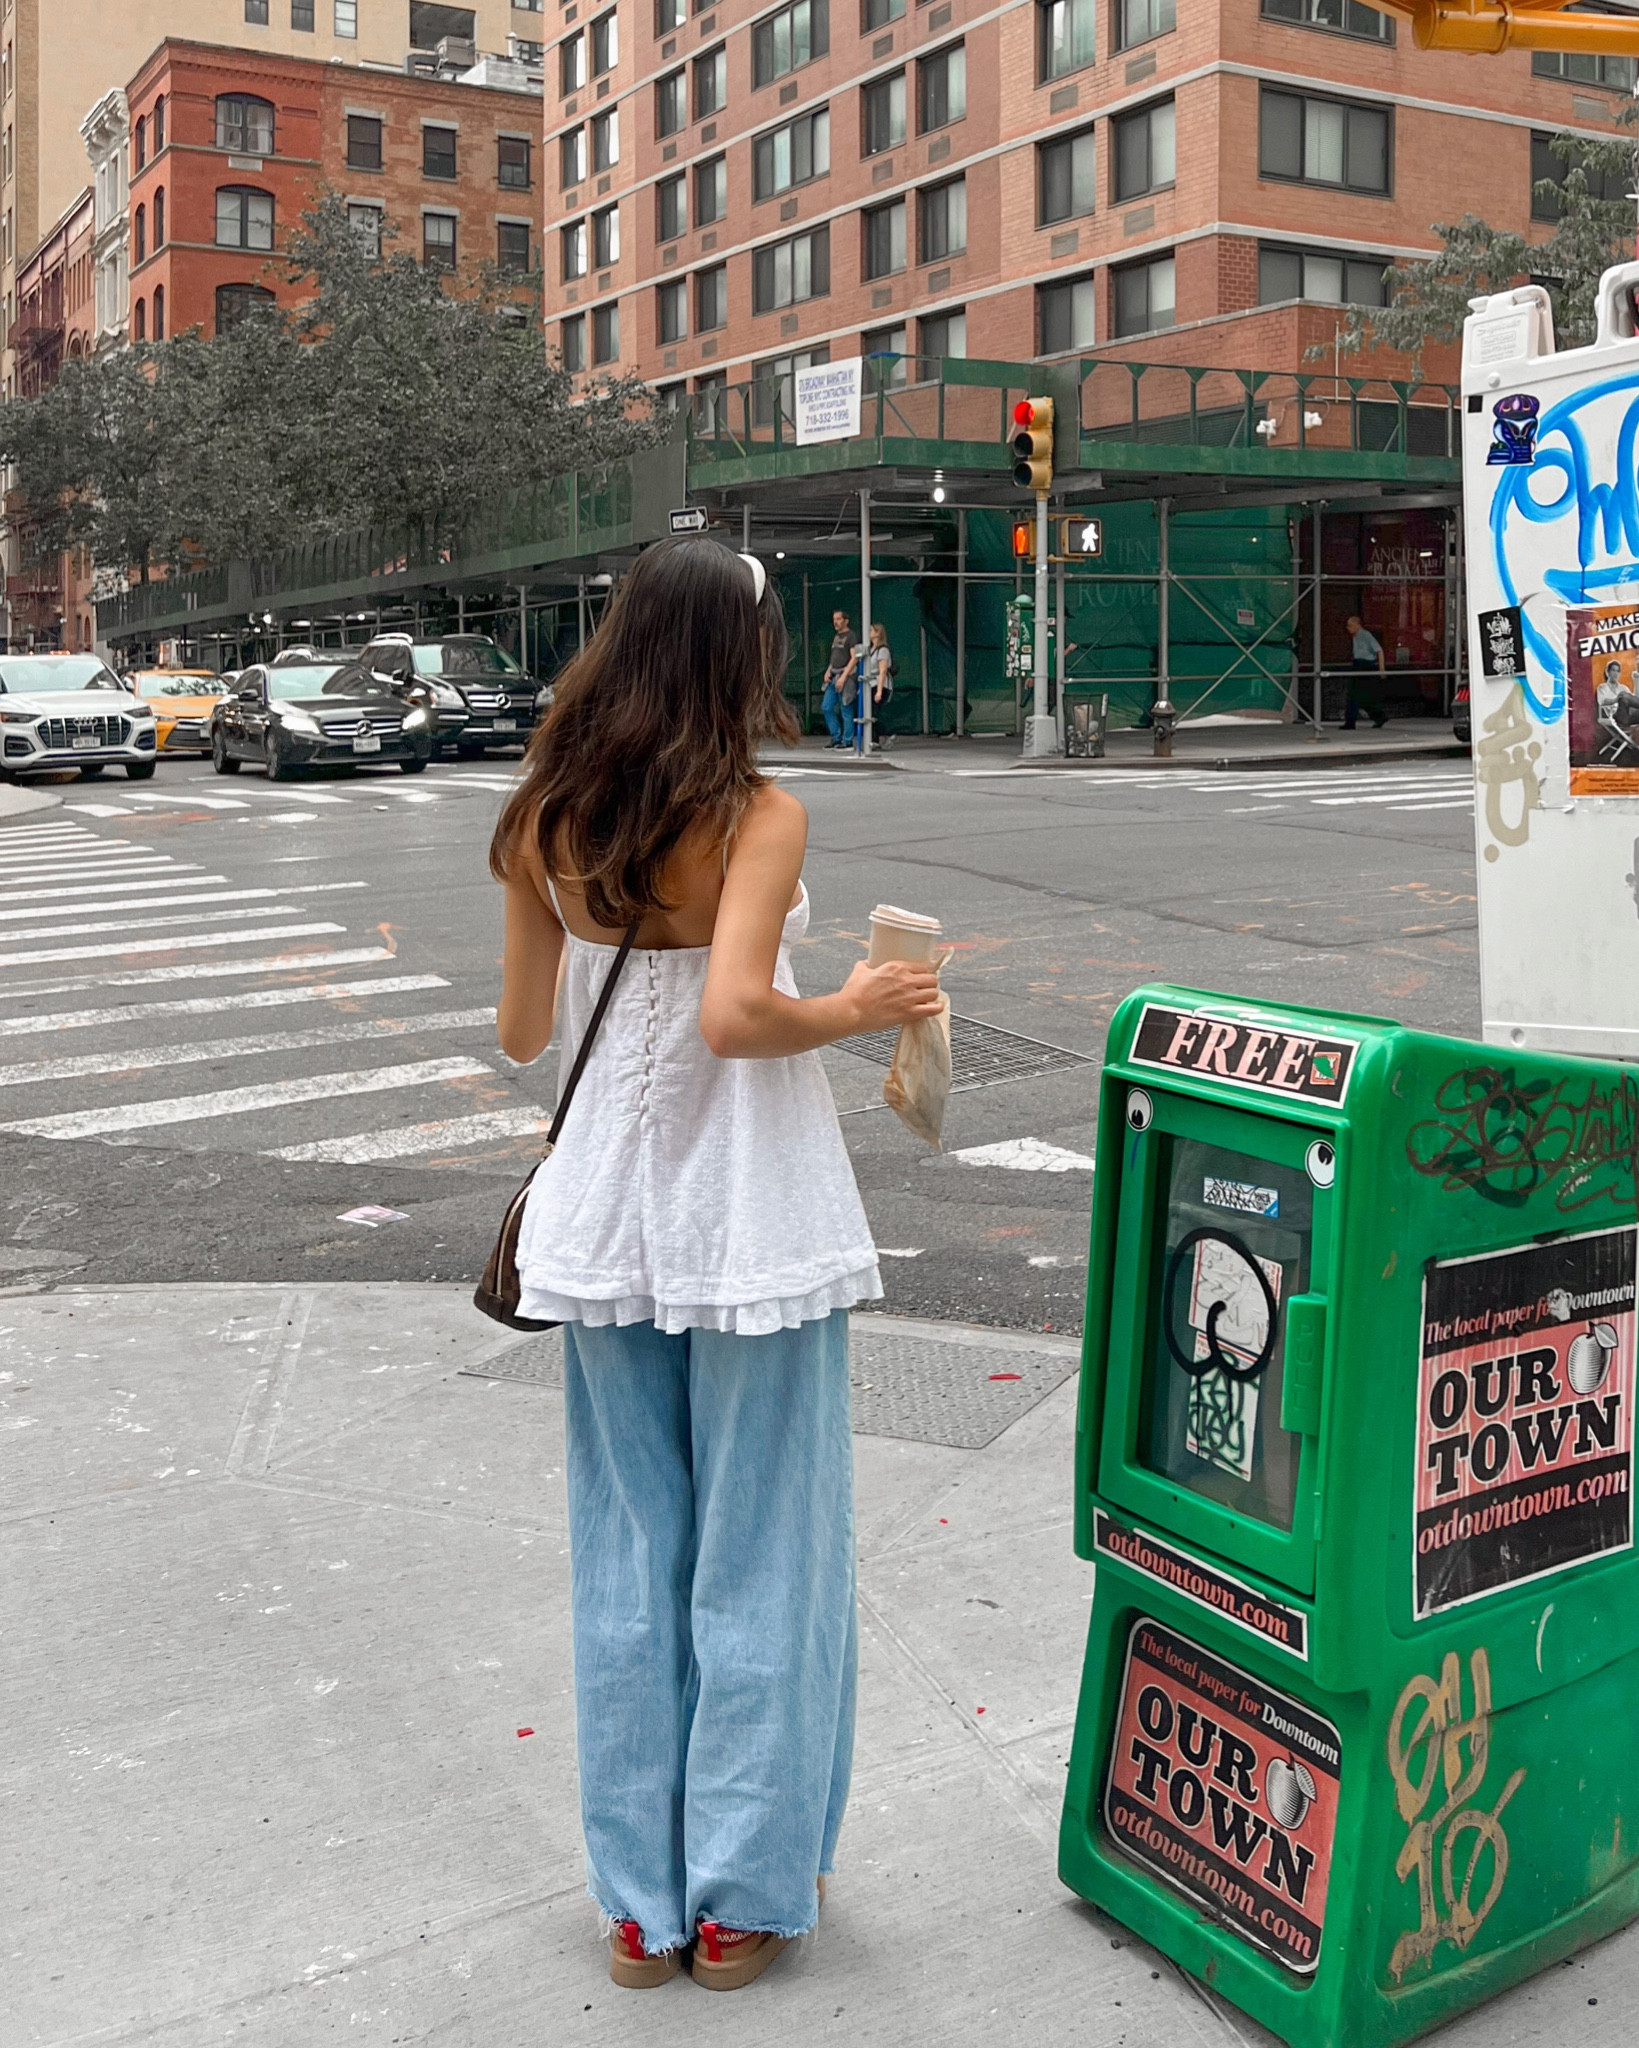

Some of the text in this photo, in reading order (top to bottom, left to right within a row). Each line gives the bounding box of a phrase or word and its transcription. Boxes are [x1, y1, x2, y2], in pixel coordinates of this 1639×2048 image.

[806, 409, 848, 426] 718-332-1996
[675, 516, 687, 528] ONE
[1596, 611, 1639, 631] MAKE
[1160, 1014, 1319, 1091] FREE
[1426, 1320, 1453, 1345] The
[1454, 1307, 1491, 1337] local
[1492, 1297, 1535, 1330] paper
[1535, 1296, 1550, 1324] fo
[1427, 1345, 1562, 1432] OUR
[1426, 1393, 1622, 1499] TOWN
[1418, 1467, 1629, 1556] otdowntown.com
[1108, 1531, 1289, 1643] otdowntown.com
[1139, 1630, 1339, 1766] The local paper for Downtown
[1137, 1684, 1258, 1803] OUR
[1131, 1735, 1316, 1907] TOWN
[1113, 1804, 1312, 1958] otdowntown.com
